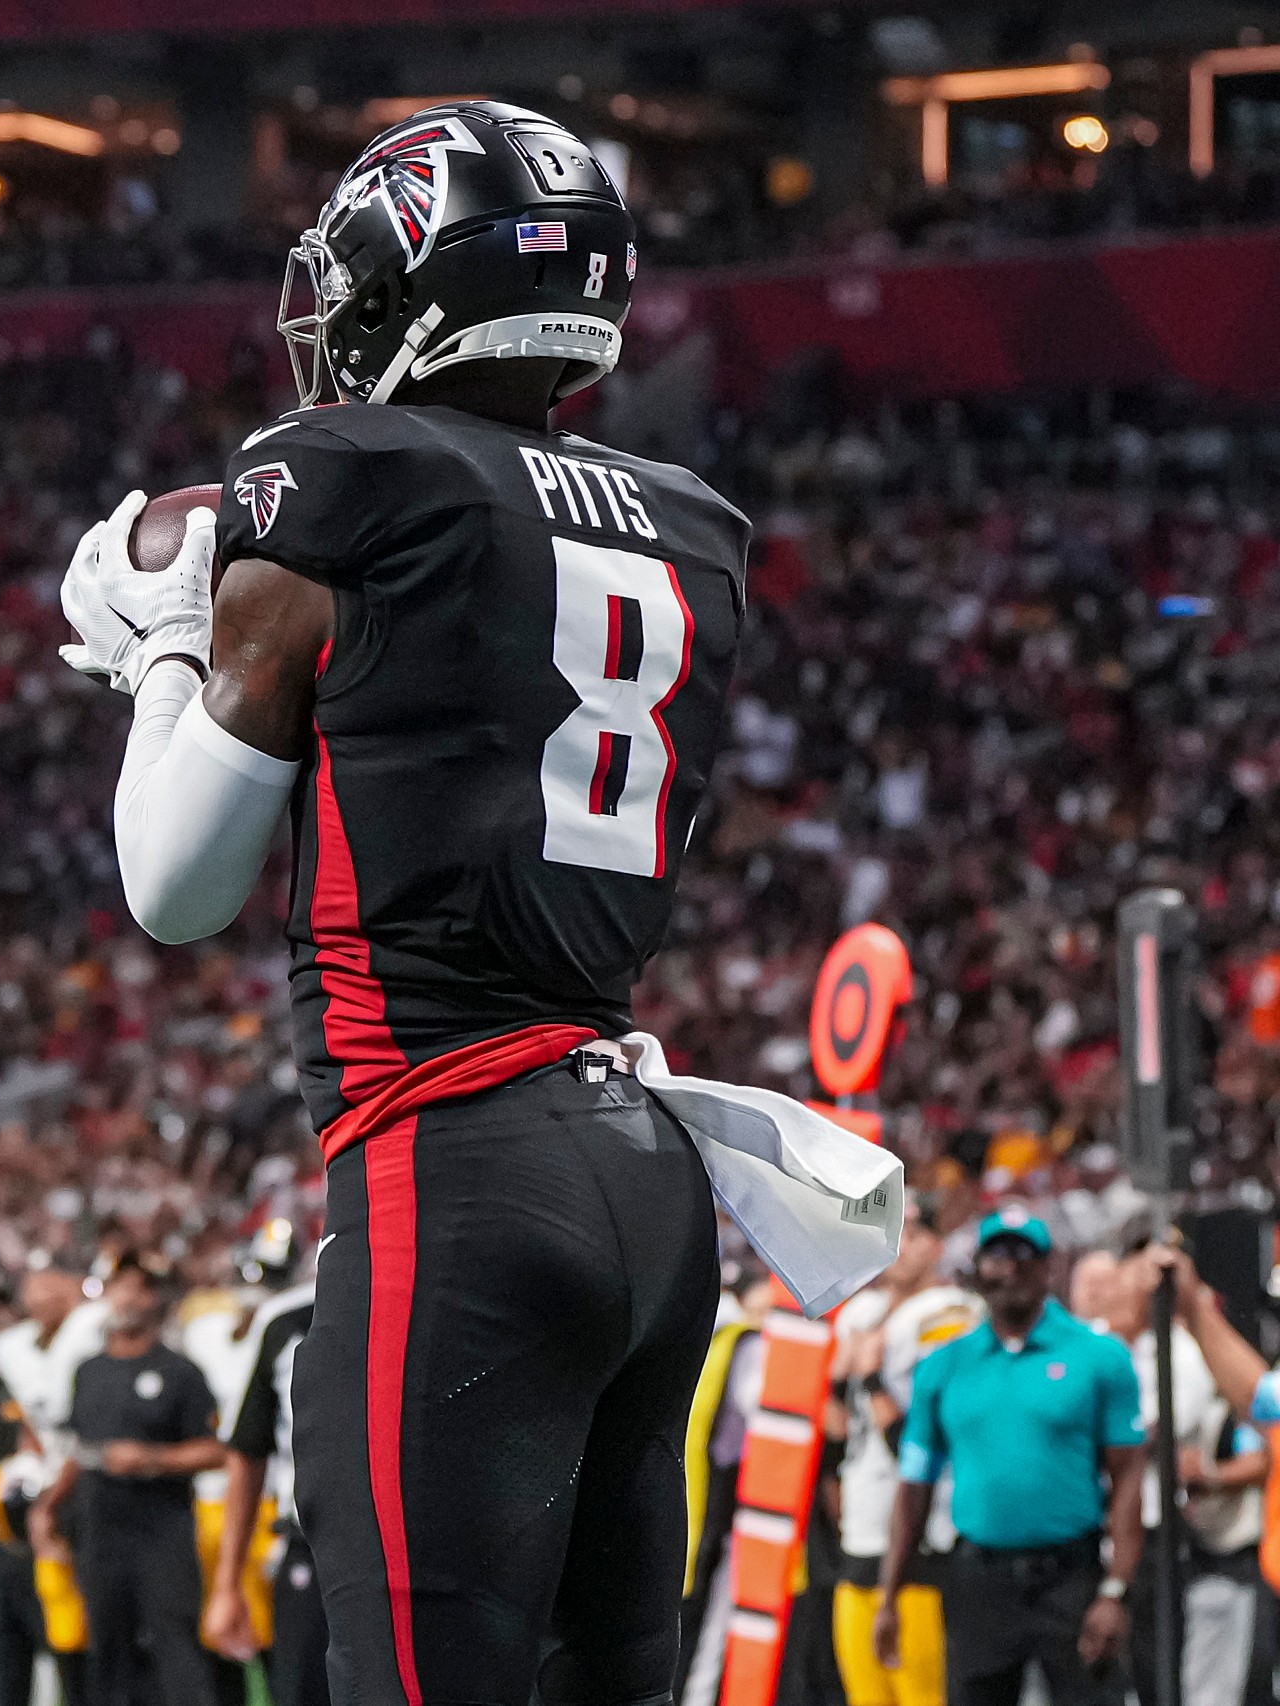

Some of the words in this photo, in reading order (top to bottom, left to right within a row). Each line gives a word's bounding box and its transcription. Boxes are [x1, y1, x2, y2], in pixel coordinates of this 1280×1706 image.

[583, 252, 608, 299] 8
[540, 323, 614, 342] FALCONS
[519, 446, 658, 541] PITTS
[540, 536, 695, 879] 8
